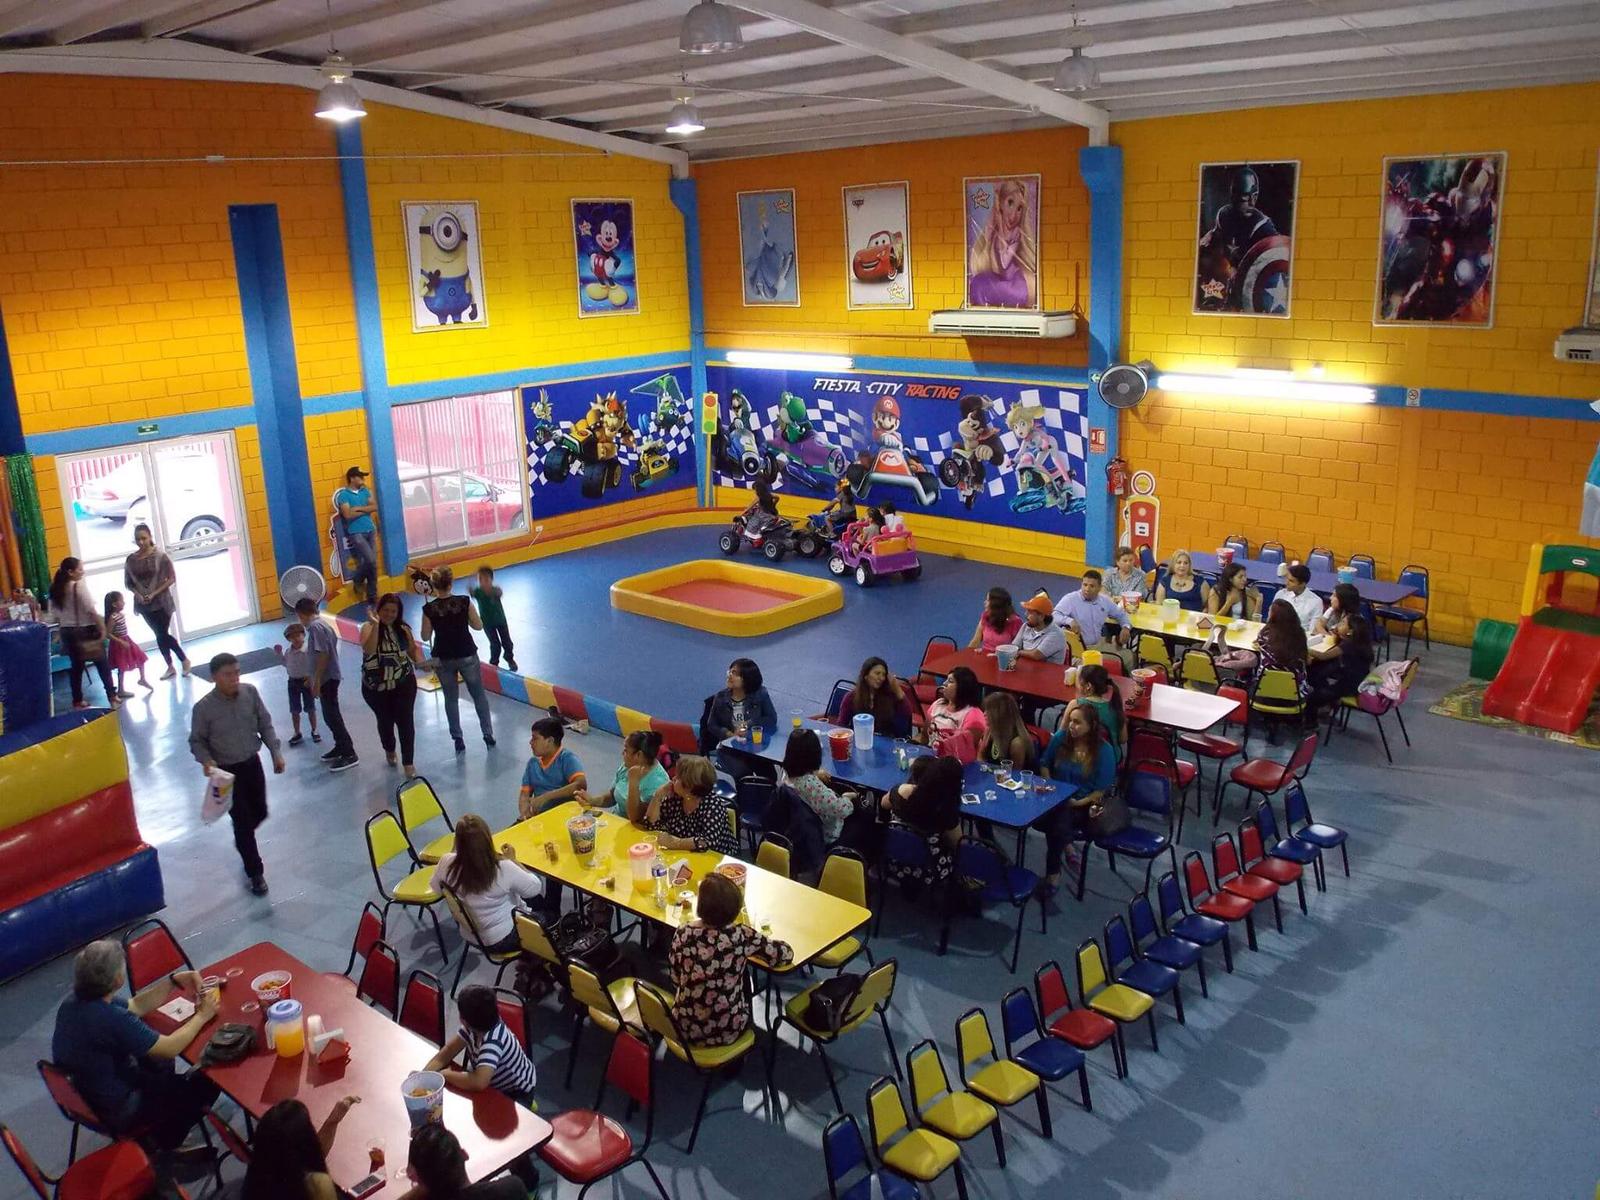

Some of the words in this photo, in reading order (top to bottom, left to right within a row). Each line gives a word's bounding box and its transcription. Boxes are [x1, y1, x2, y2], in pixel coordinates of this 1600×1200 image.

[813, 378, 861, 393] FIESTA
[866, 381, 902, 396] CITY
[905, 384, 961, 400] RACING
